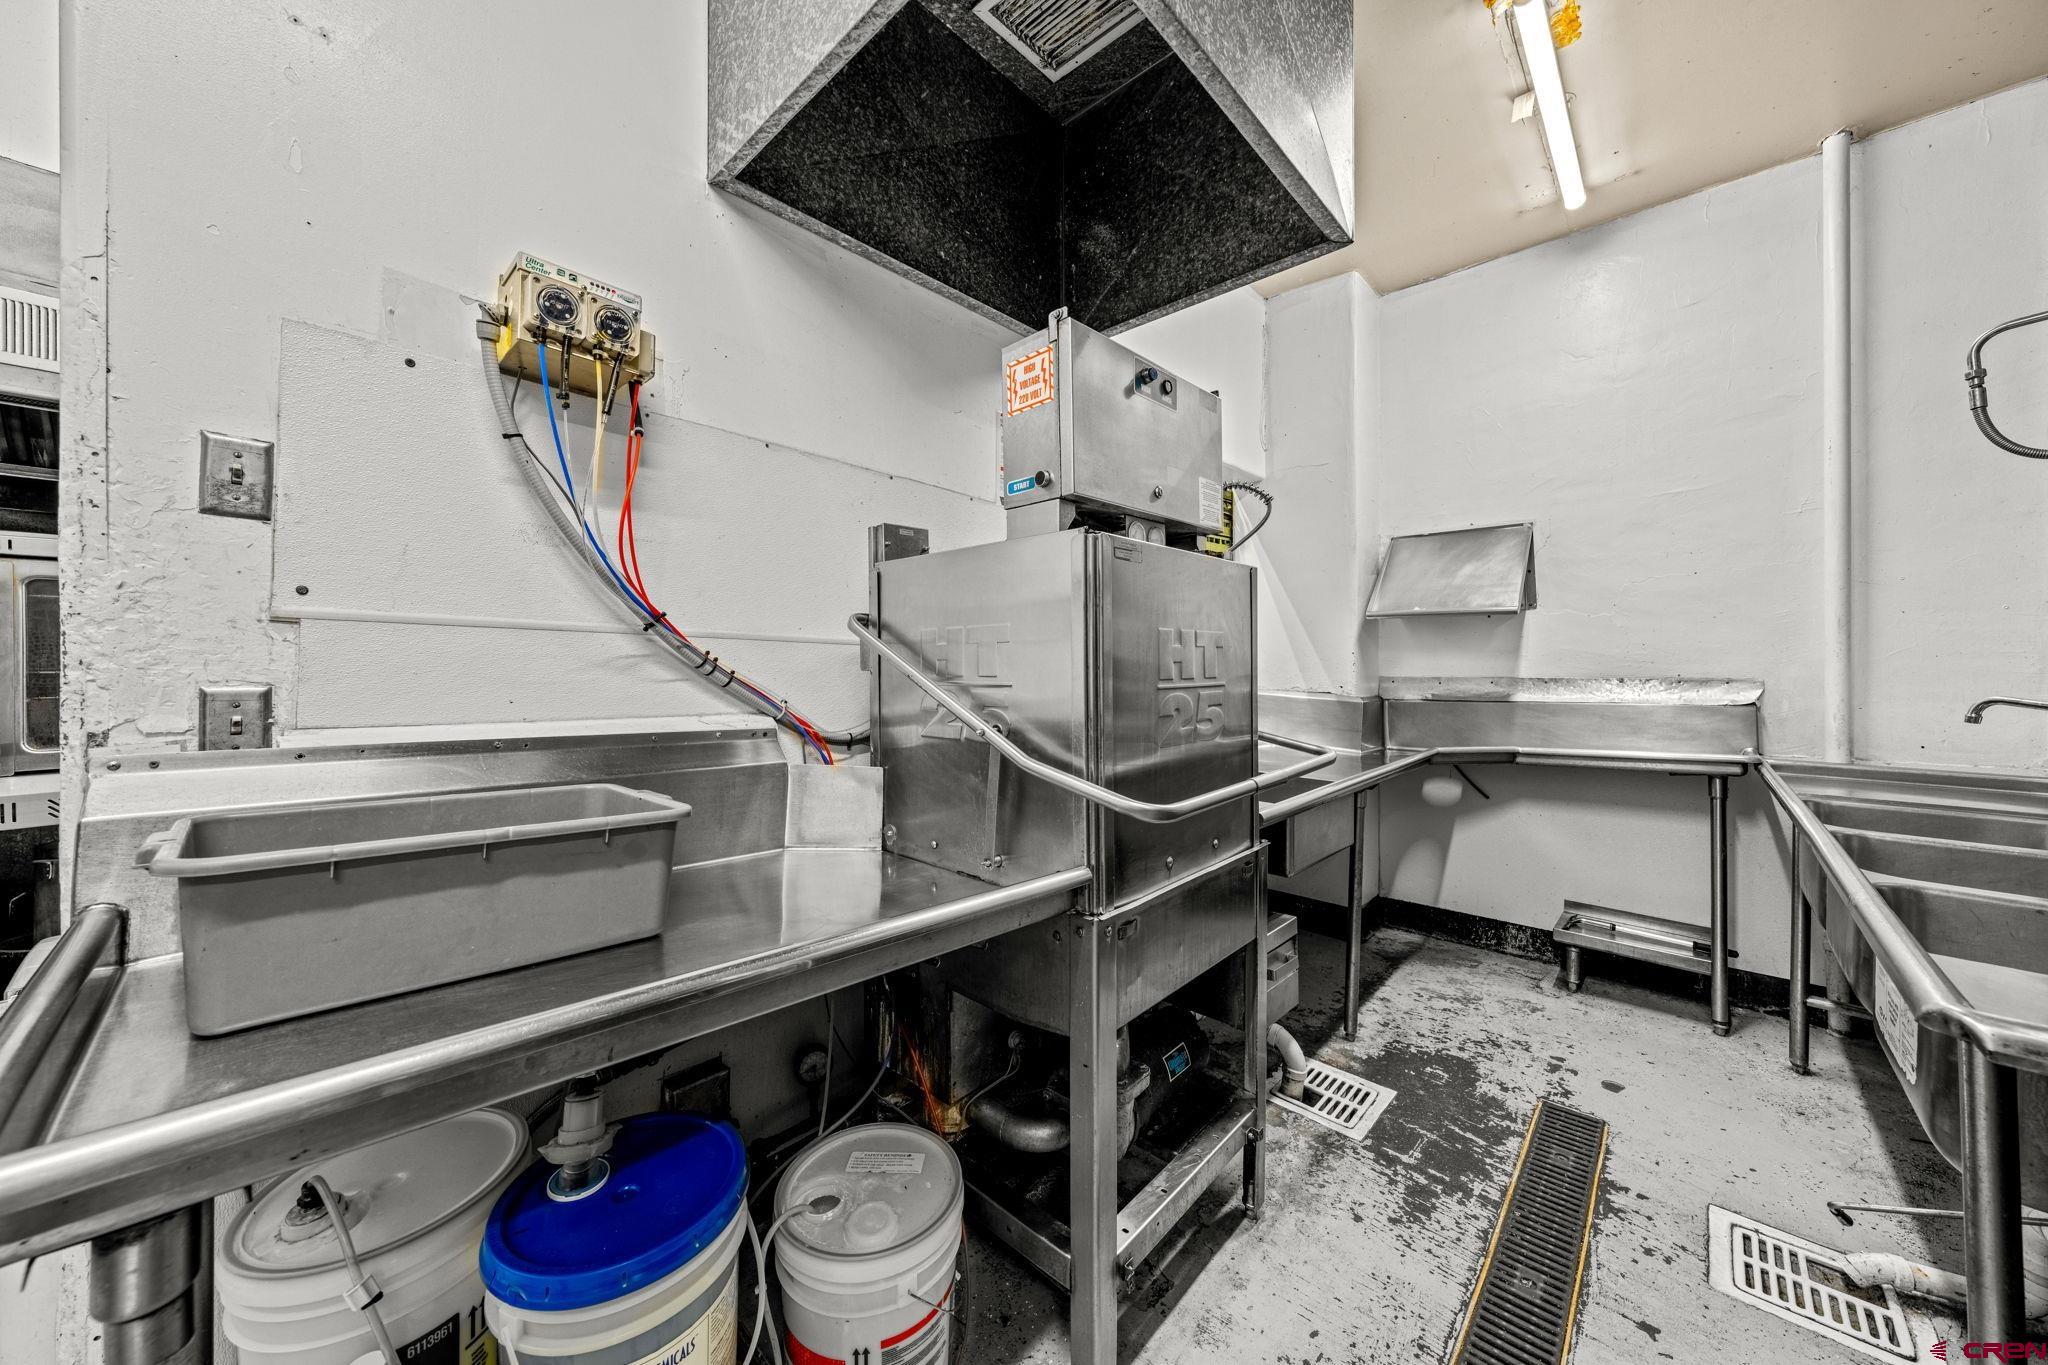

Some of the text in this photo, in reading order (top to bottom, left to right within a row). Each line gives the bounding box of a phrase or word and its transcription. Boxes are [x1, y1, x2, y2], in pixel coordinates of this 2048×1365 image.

[525, 256, 545, 268] Ultra
[1023, 362, 1036, 375] HIGH
[1019, 373, 1041, 390] VOLTAGE
[1029, 387, 1042, 401] VOLT
[1013, 481, 1031, 491] START
[920, 623, 1009, 678] HT
[1158, 626, 1225, 681] HT
[1158, 690, 1225, 748] 25
[407, 1321, 454, 1359] 6113961
